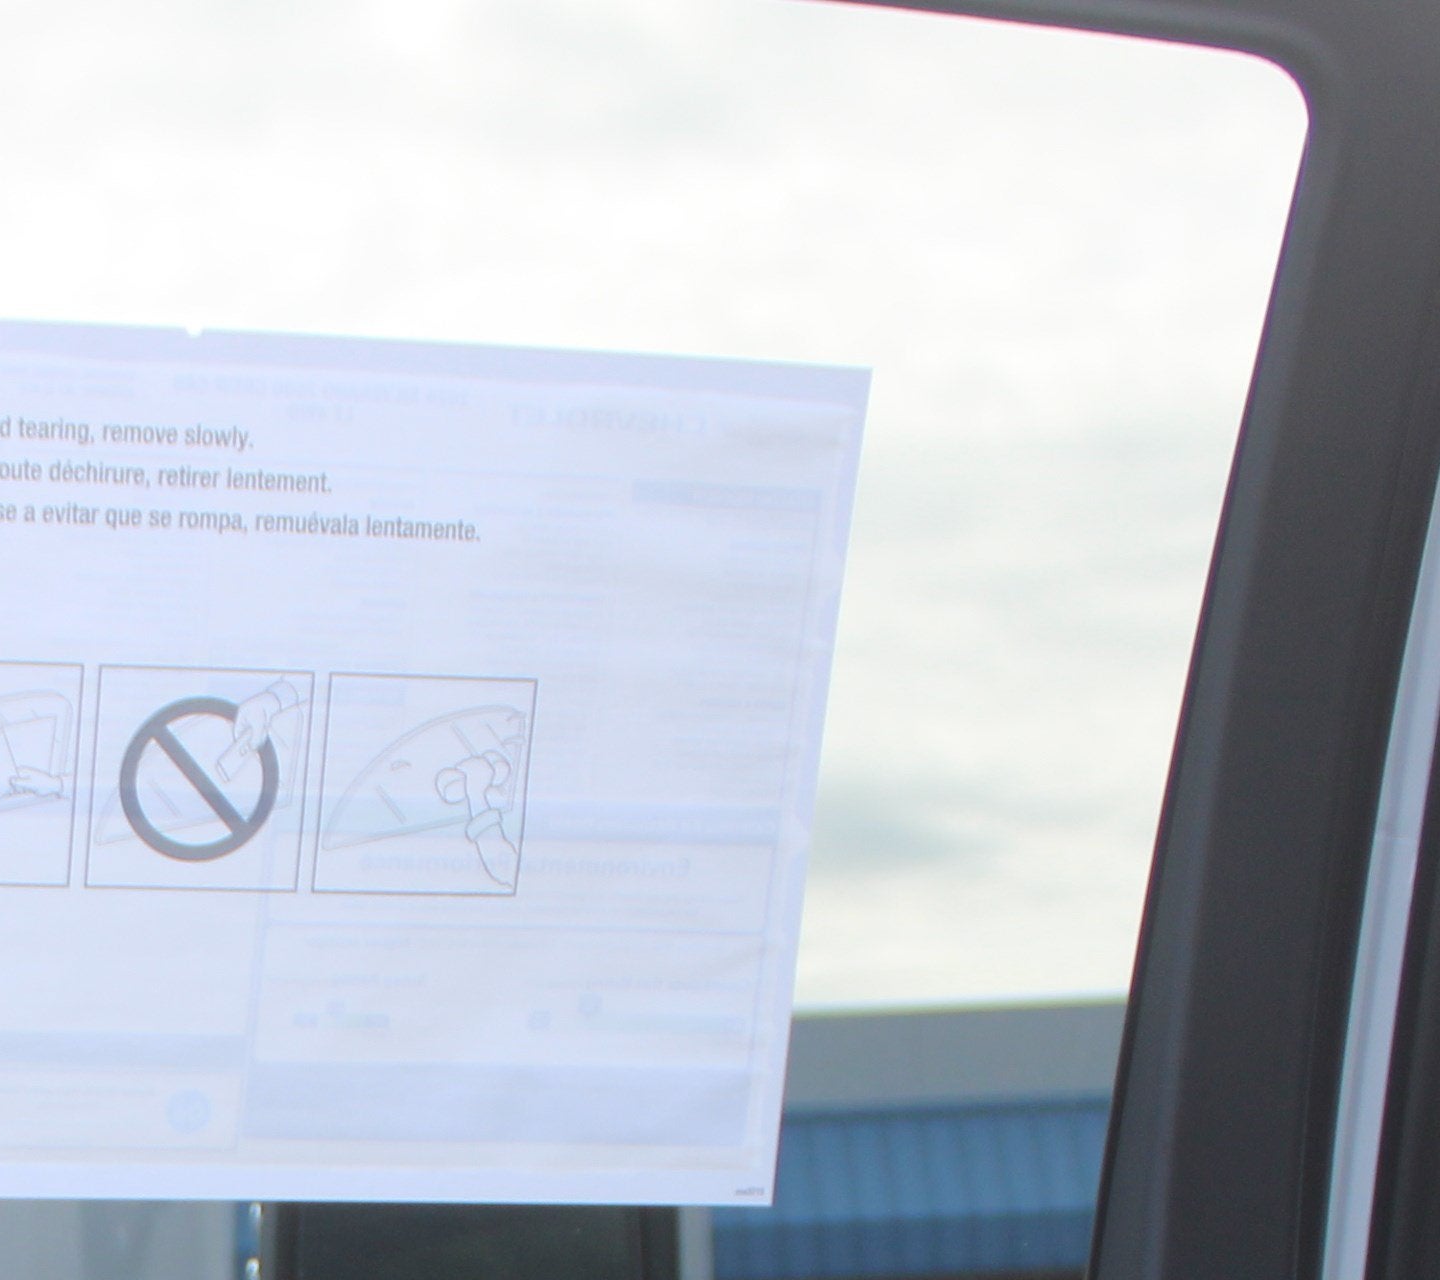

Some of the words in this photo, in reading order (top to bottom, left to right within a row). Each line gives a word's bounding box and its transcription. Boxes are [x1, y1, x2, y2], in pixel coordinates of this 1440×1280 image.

[18, 419, 94, 446] tearing,
[102, 424, 178, 445] remove
[184, 426, 254, 451] slowly.
[49, 460, 151, 489] déchirure,
[157, 465, 218, 490] retirer
[226, 468, 332, 494] lentement.
[24, 505, 37, 523] a
[42, 502, 100, 526] evitar
[105, 508, 142, 531] que
[149, 509, 172, 529] se
[179, 510, 247, 535] rompa,
[255, 510, 359, 537] remuévala
[366, 514, 481, 543] lentamente.
